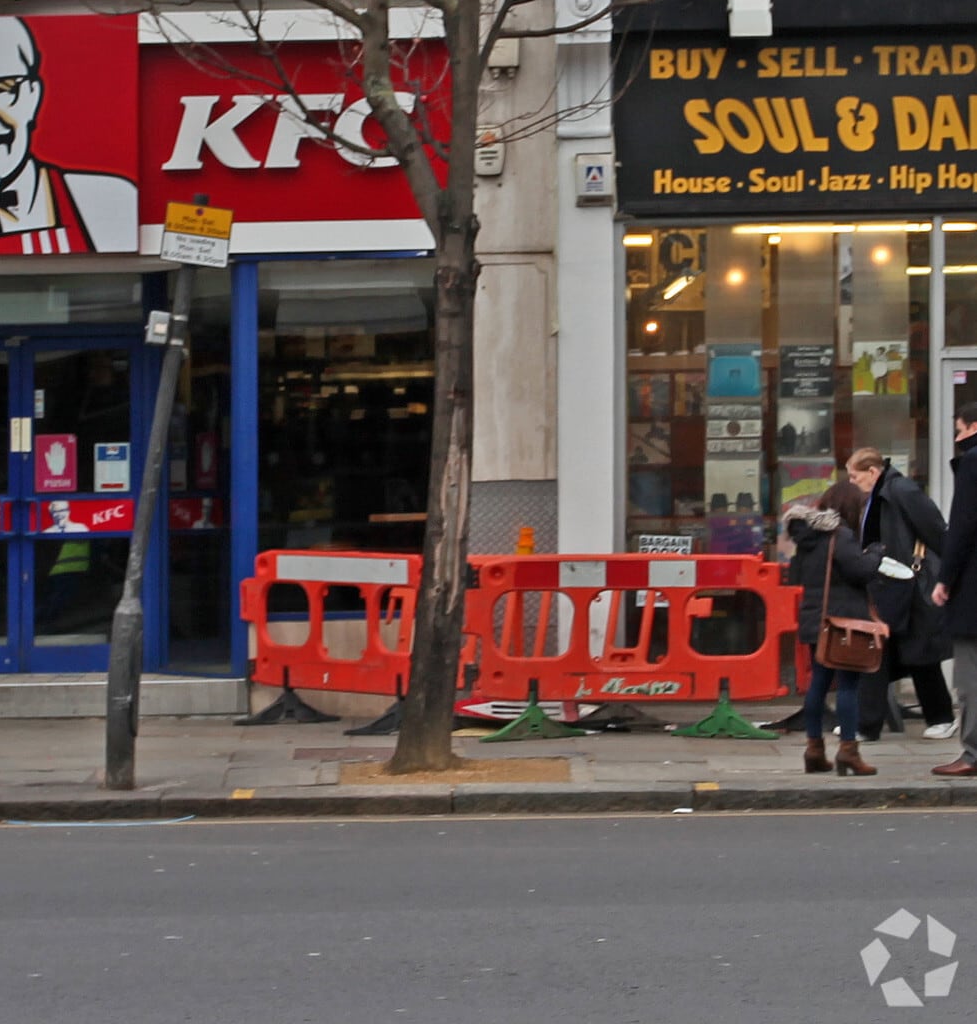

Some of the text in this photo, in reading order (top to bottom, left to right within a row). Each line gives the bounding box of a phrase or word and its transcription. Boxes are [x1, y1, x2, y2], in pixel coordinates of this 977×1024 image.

[650, 44, 976, 80] BUY SELL TRAD
[161, 92, 415, 170] KFC
[683, 94, 977, 154] SOUL & DA
[653, 168, 731, 194] House
[748, 167, 804, 193] Soul
[819, 166, 871, 192] Jazz
[890, 164, 933, 194] Hip
[44, 479, 71, 488] PUSH
[92, 504, 125, 526] KFC
[640, 537, 689, 546] BARGAIN
